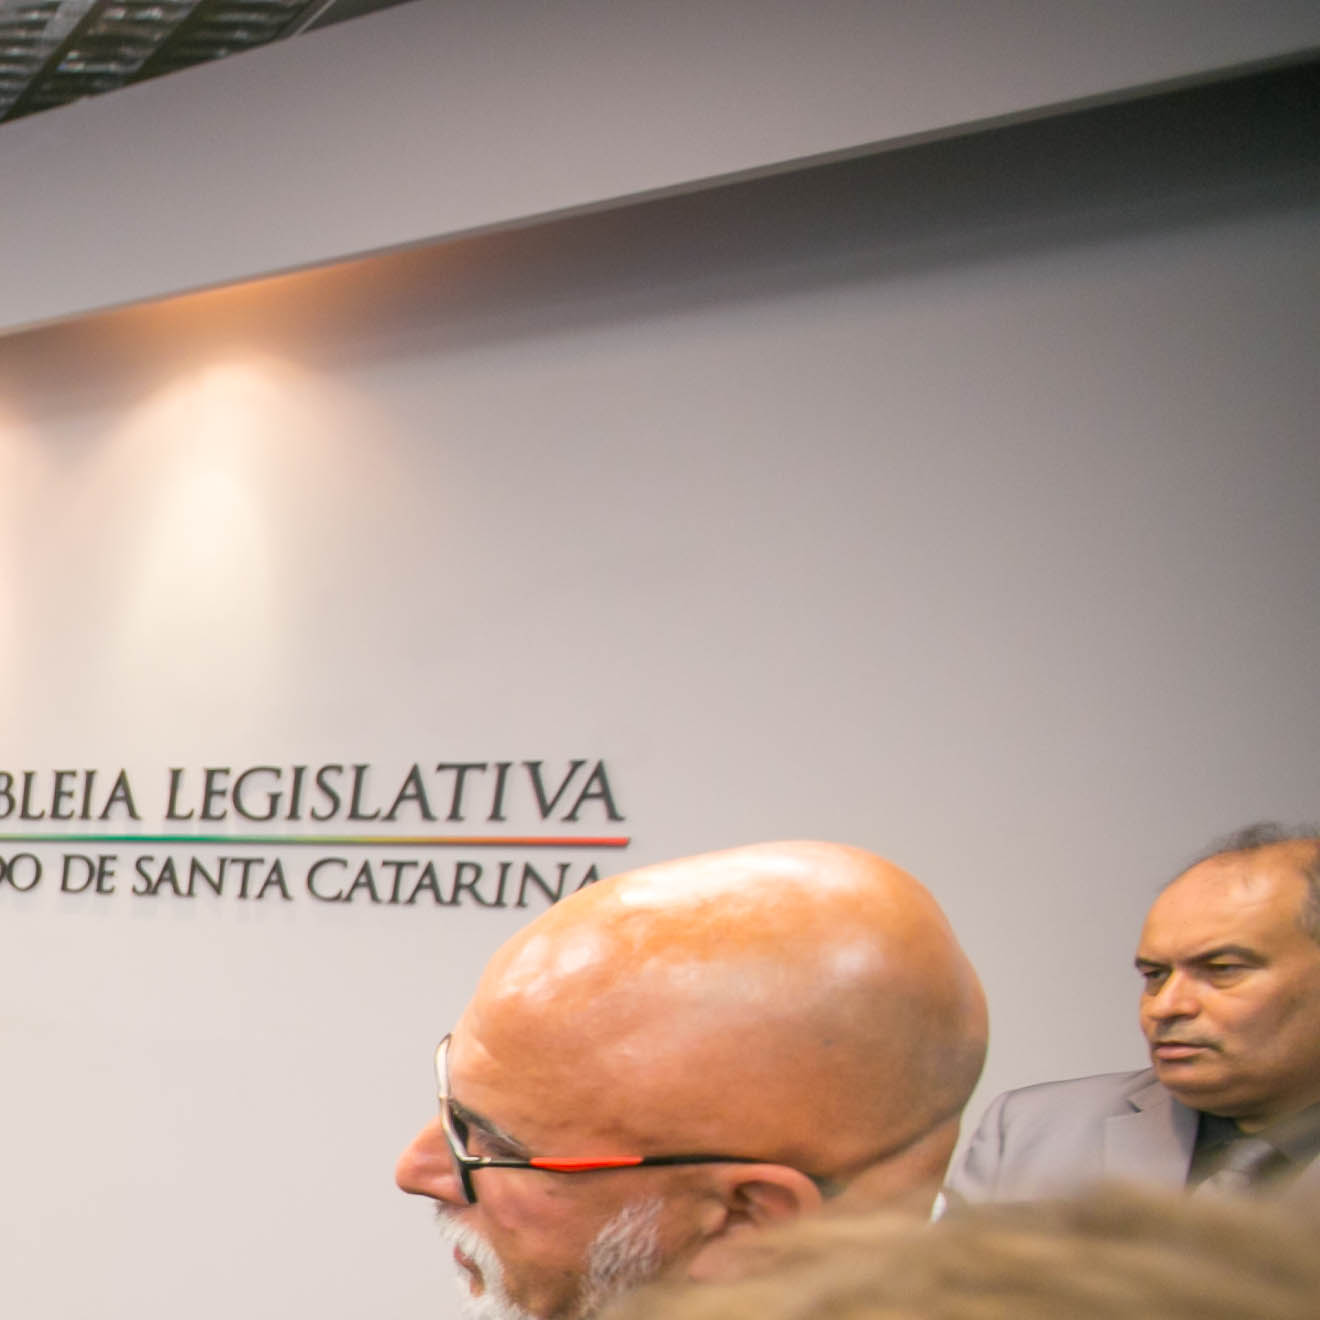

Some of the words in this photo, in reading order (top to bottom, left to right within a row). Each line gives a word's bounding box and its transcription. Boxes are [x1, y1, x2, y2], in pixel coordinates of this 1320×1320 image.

[164, 759, 626, 822] LEGISLATIVA
[60, 854, 118, 895] DE
[132, 854, 294, 901] SANTA
